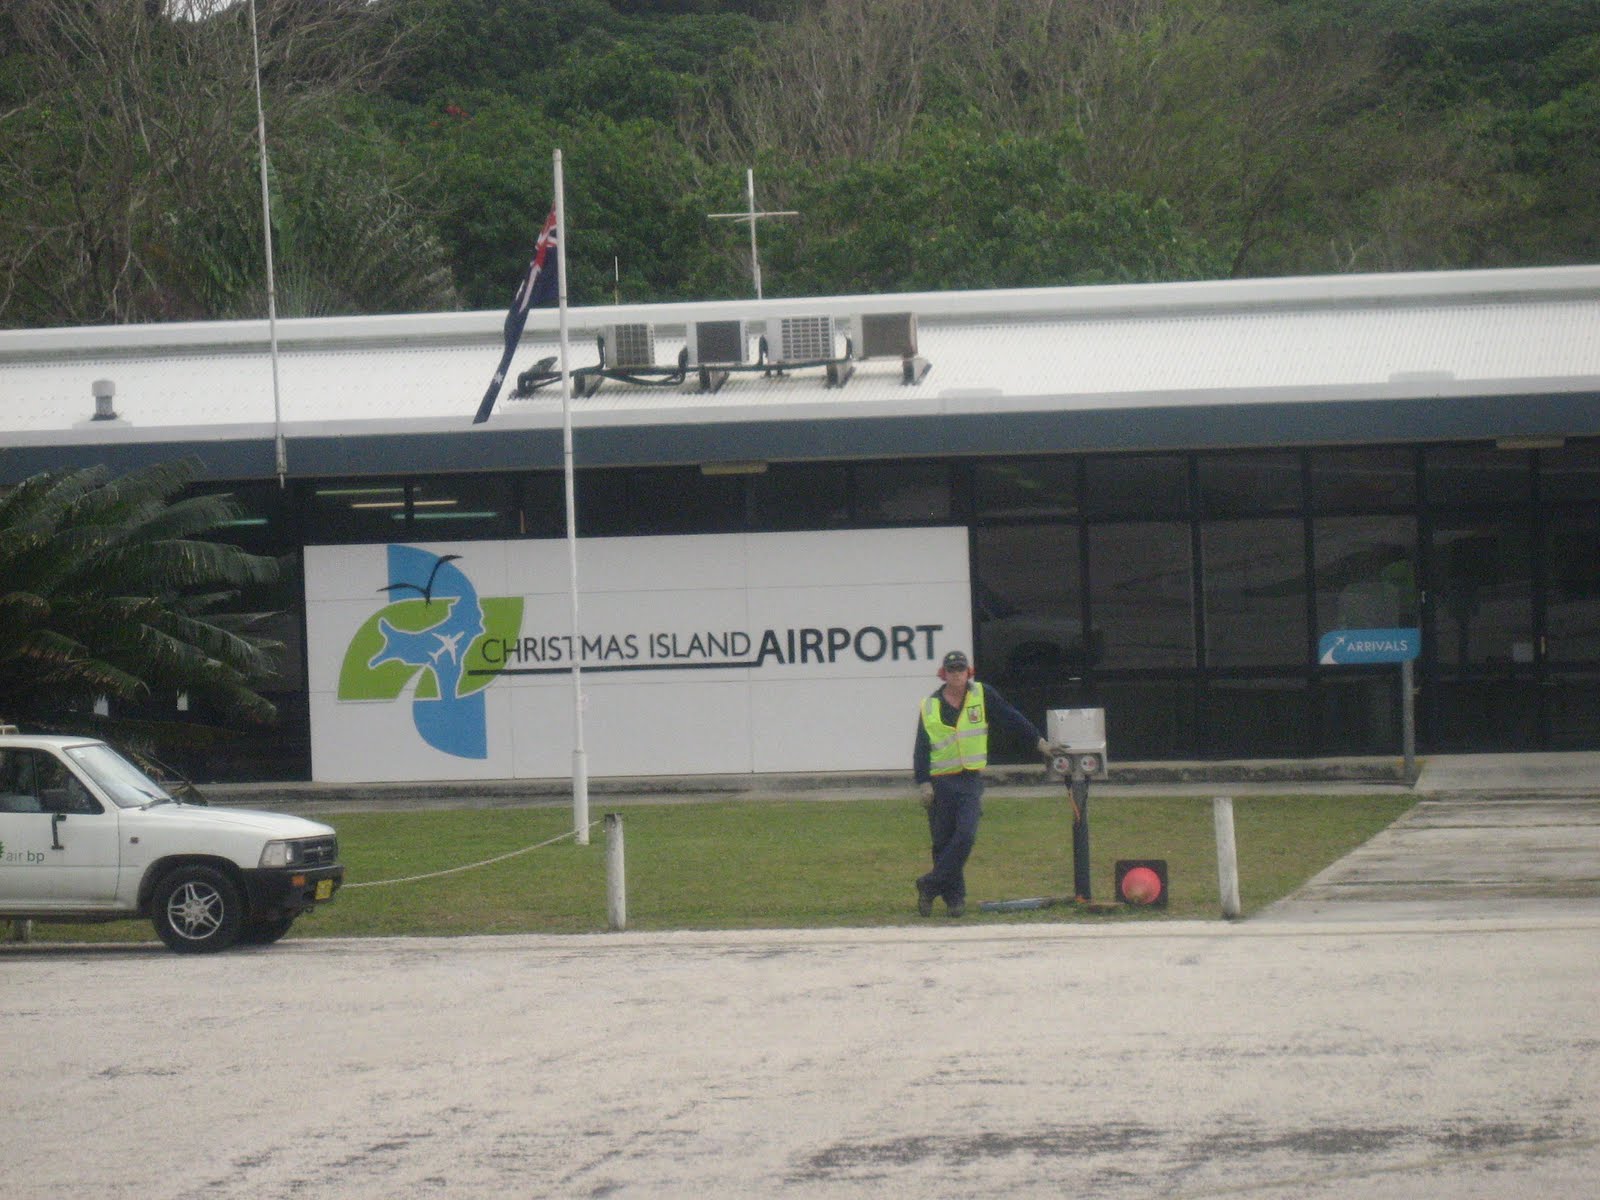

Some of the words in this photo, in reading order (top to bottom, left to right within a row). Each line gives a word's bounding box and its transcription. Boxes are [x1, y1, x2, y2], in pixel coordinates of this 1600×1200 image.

[481, 634, 639, 664] CHRISTMAS
[649, 631, 751, 659] ISLAND
[757, 624, 944, 665] AIRPORT
[1347, 640, 1409, 652] ARRIVALS
[6, 850, 23, 861] air
[27, 850, 45, 864] bp
